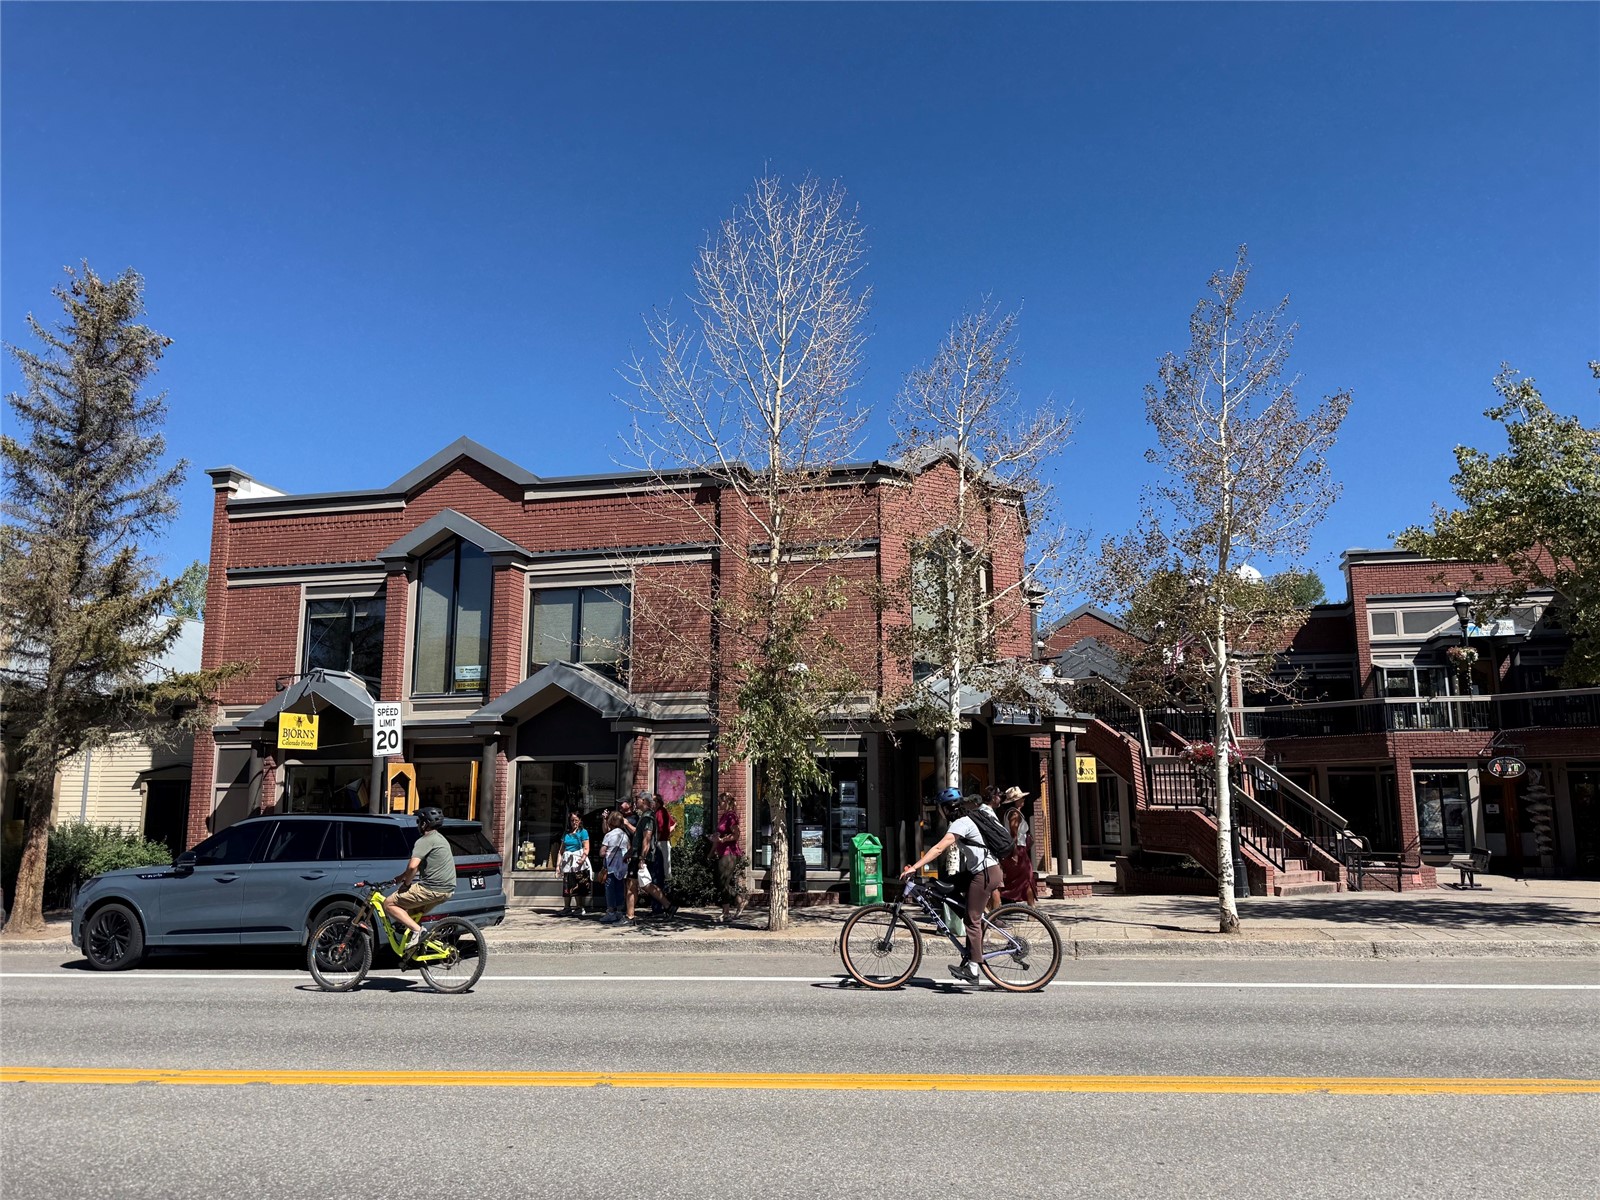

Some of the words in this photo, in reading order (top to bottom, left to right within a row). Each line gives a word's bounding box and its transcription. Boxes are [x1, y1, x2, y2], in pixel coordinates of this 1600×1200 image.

[377, 707, 399, 716] SPEED
[379, 718, 396, 727] LIMIT
[300, 740, 314, 748] Honey
[376, 729, 399, 750] 20
